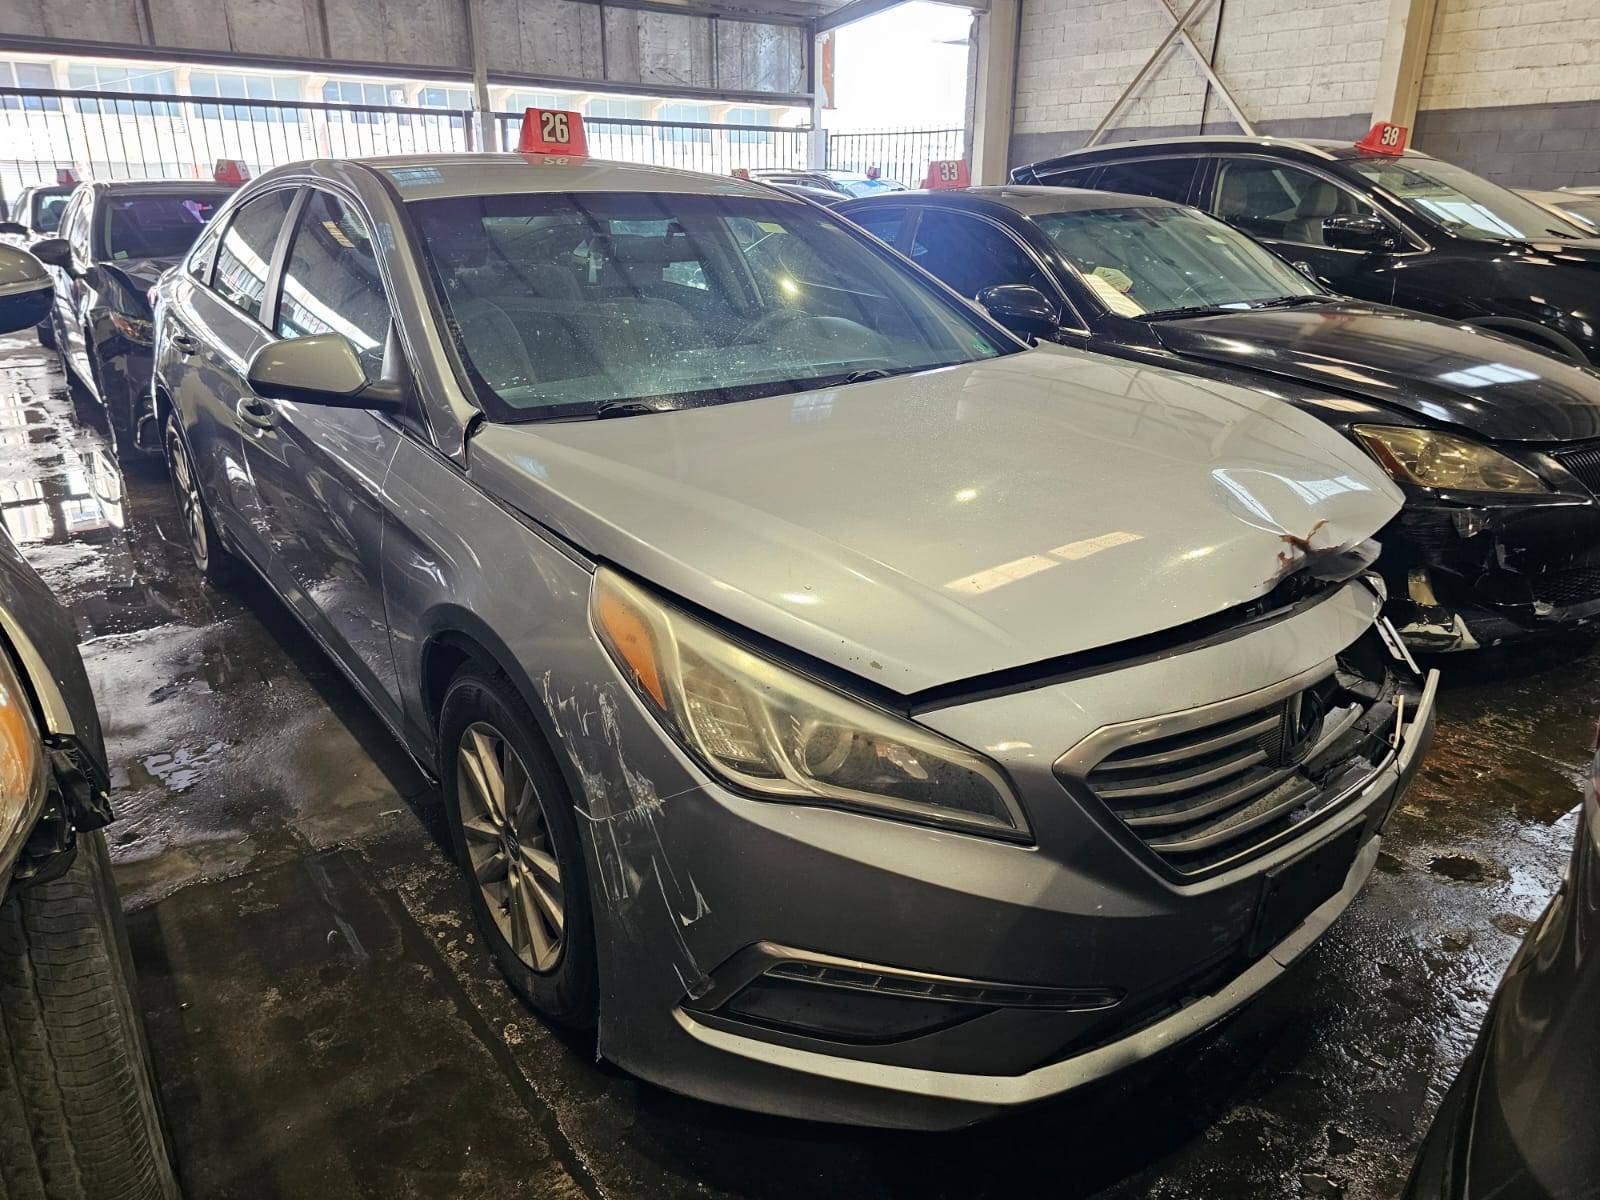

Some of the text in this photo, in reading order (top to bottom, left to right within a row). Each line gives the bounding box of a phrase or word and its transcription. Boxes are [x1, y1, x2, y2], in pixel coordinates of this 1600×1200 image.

[541, 112, 569, 143] 26
[1381, 126, 1400, 146] 38
[940, 161, 959, 181] 33
